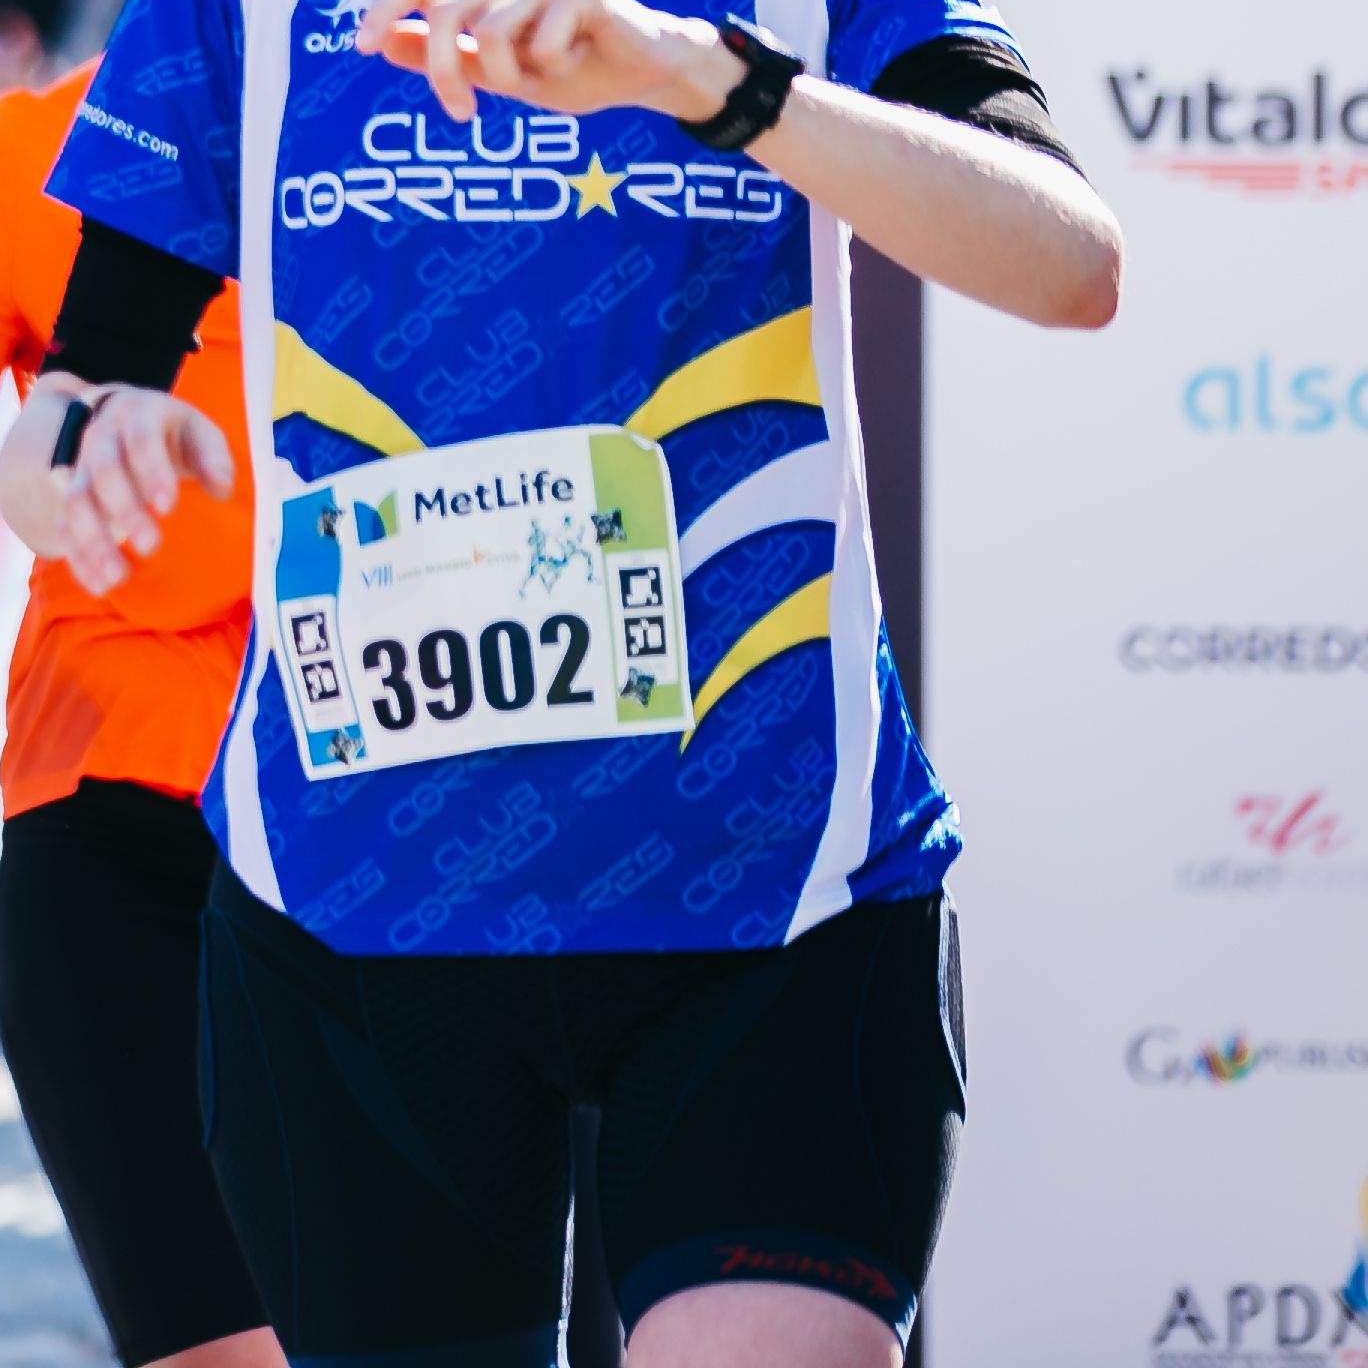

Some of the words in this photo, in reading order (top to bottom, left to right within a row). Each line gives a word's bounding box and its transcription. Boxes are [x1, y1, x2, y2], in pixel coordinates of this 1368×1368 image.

[363, 113, 580, 163] CLUB
[414, 470, 575, 524] MetLife
[361, 563, 394, 591] VIII
[362, 613, 595, 731] 3902
